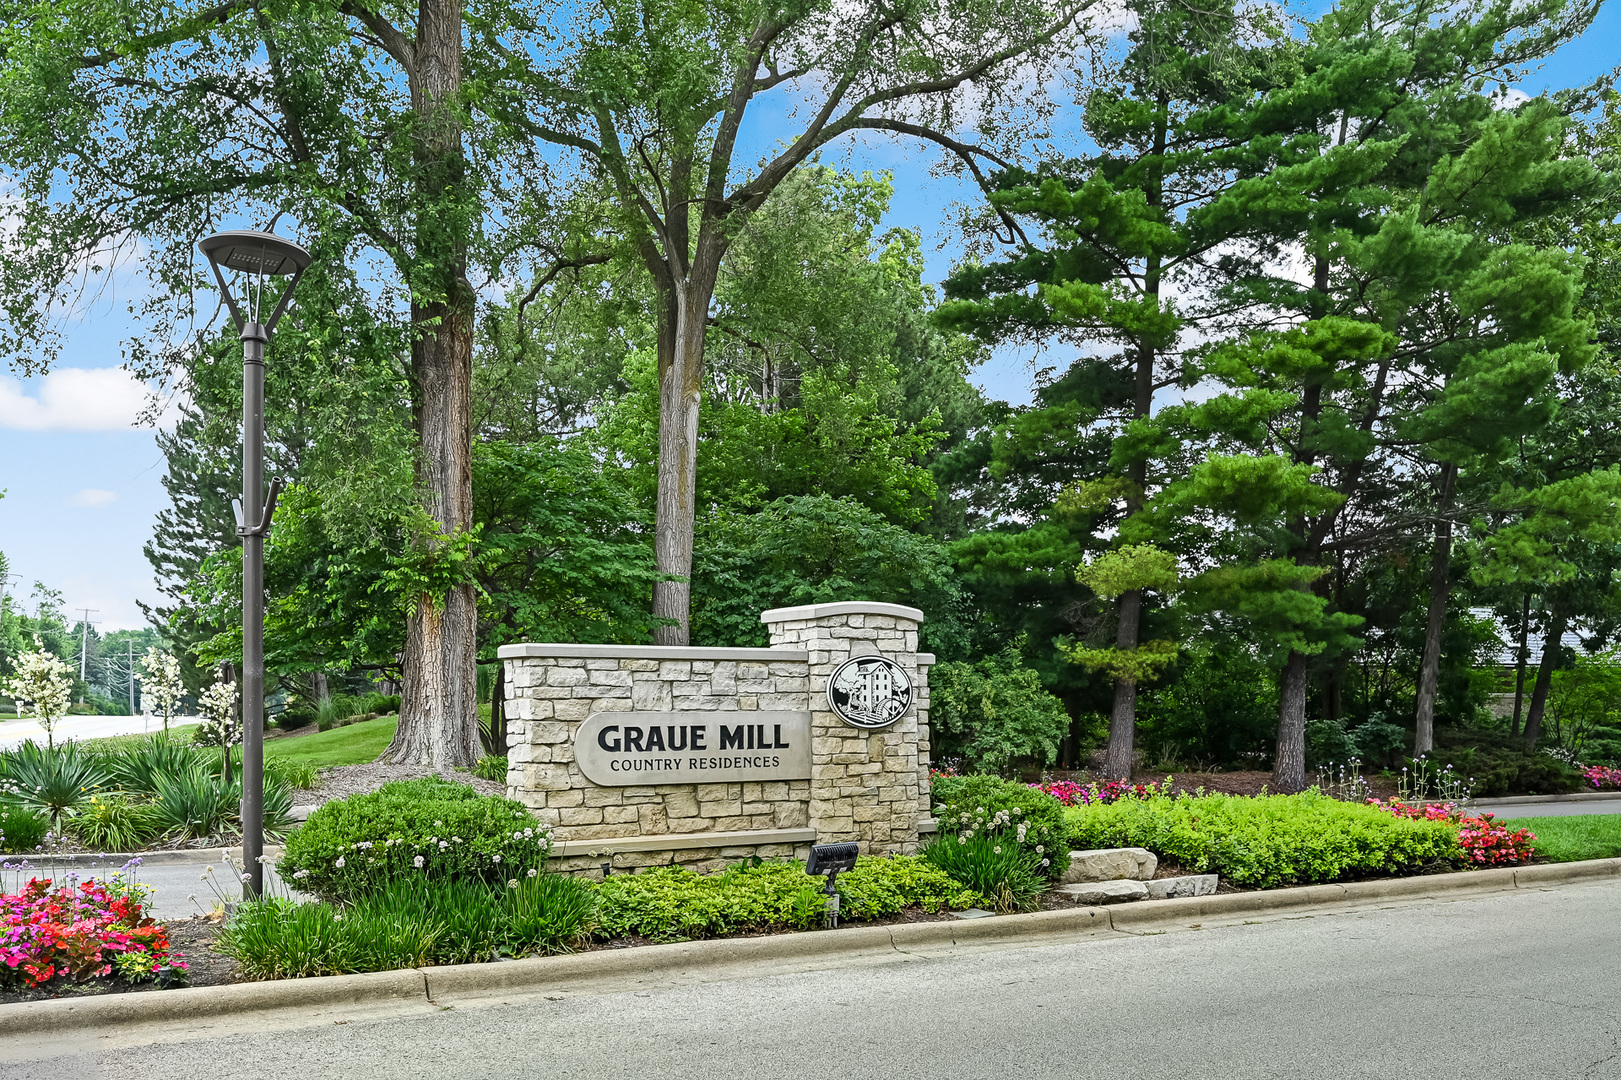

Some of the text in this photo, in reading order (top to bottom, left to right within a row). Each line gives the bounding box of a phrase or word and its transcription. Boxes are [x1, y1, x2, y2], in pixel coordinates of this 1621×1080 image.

[597, 724, 790, 753] GRAUE MILL
[610, 756, 780, 772] COUNTRY RESIDENCES
